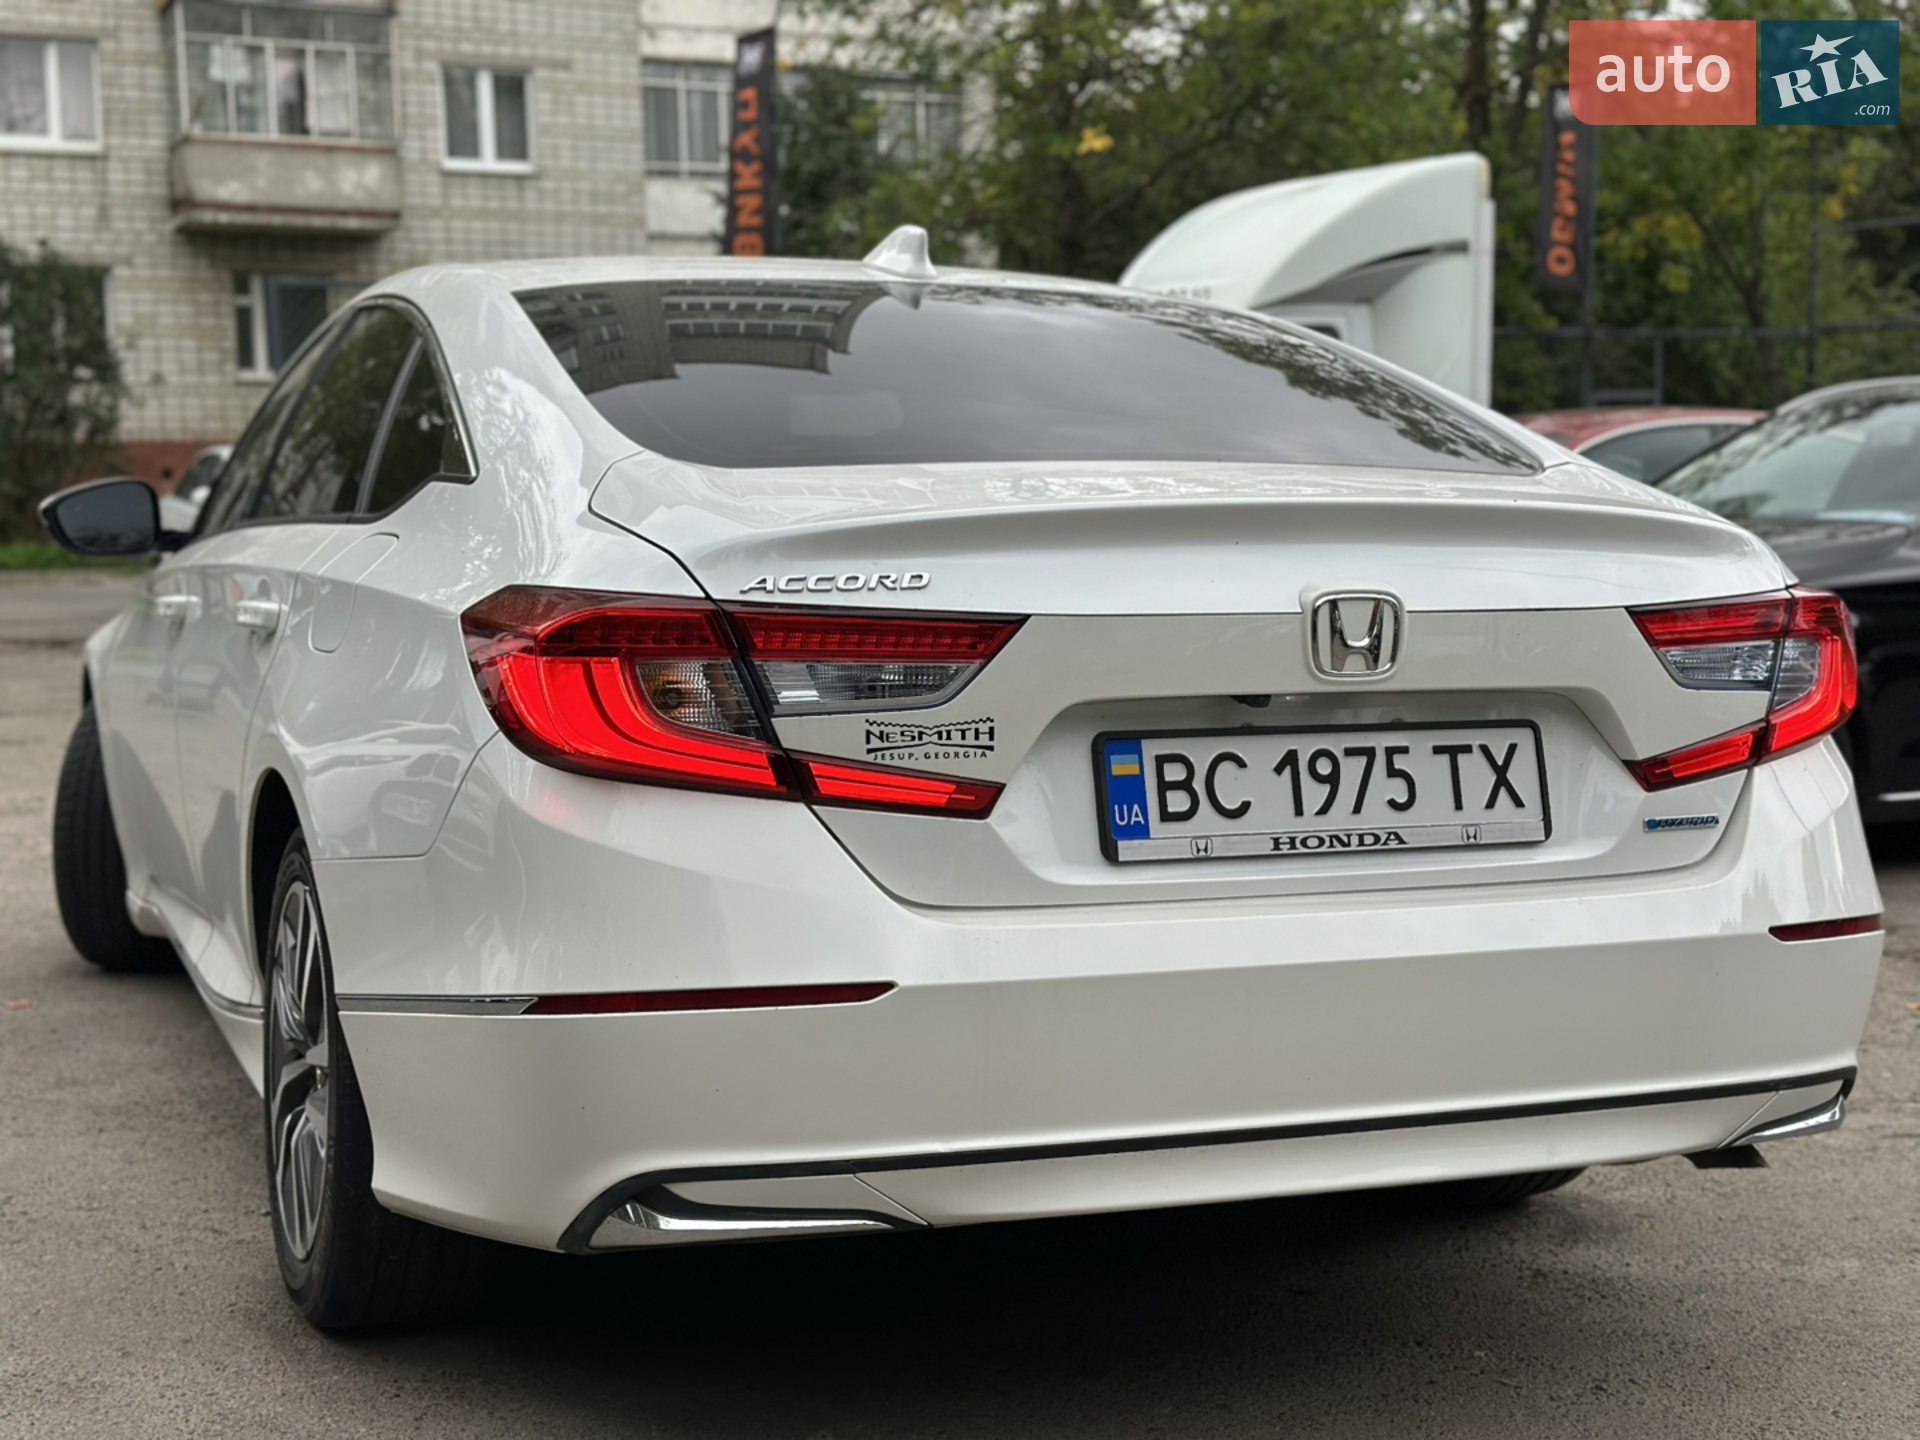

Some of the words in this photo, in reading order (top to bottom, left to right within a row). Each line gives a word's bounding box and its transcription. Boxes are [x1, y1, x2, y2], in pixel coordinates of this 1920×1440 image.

[740, 572, 931, 594] ACCORD
[873, 752, 919, 761] JESUP,
[924, 751, 988, 760] GEORGIA
[1154, 751, 1252, 822] BC
[1272, 746, 1417, 818] 1975
[1432, 742, 1526, 811] TX
[1114, 804, 1145, 826] UA
[1269, 831, 1408, 851] HONDA
